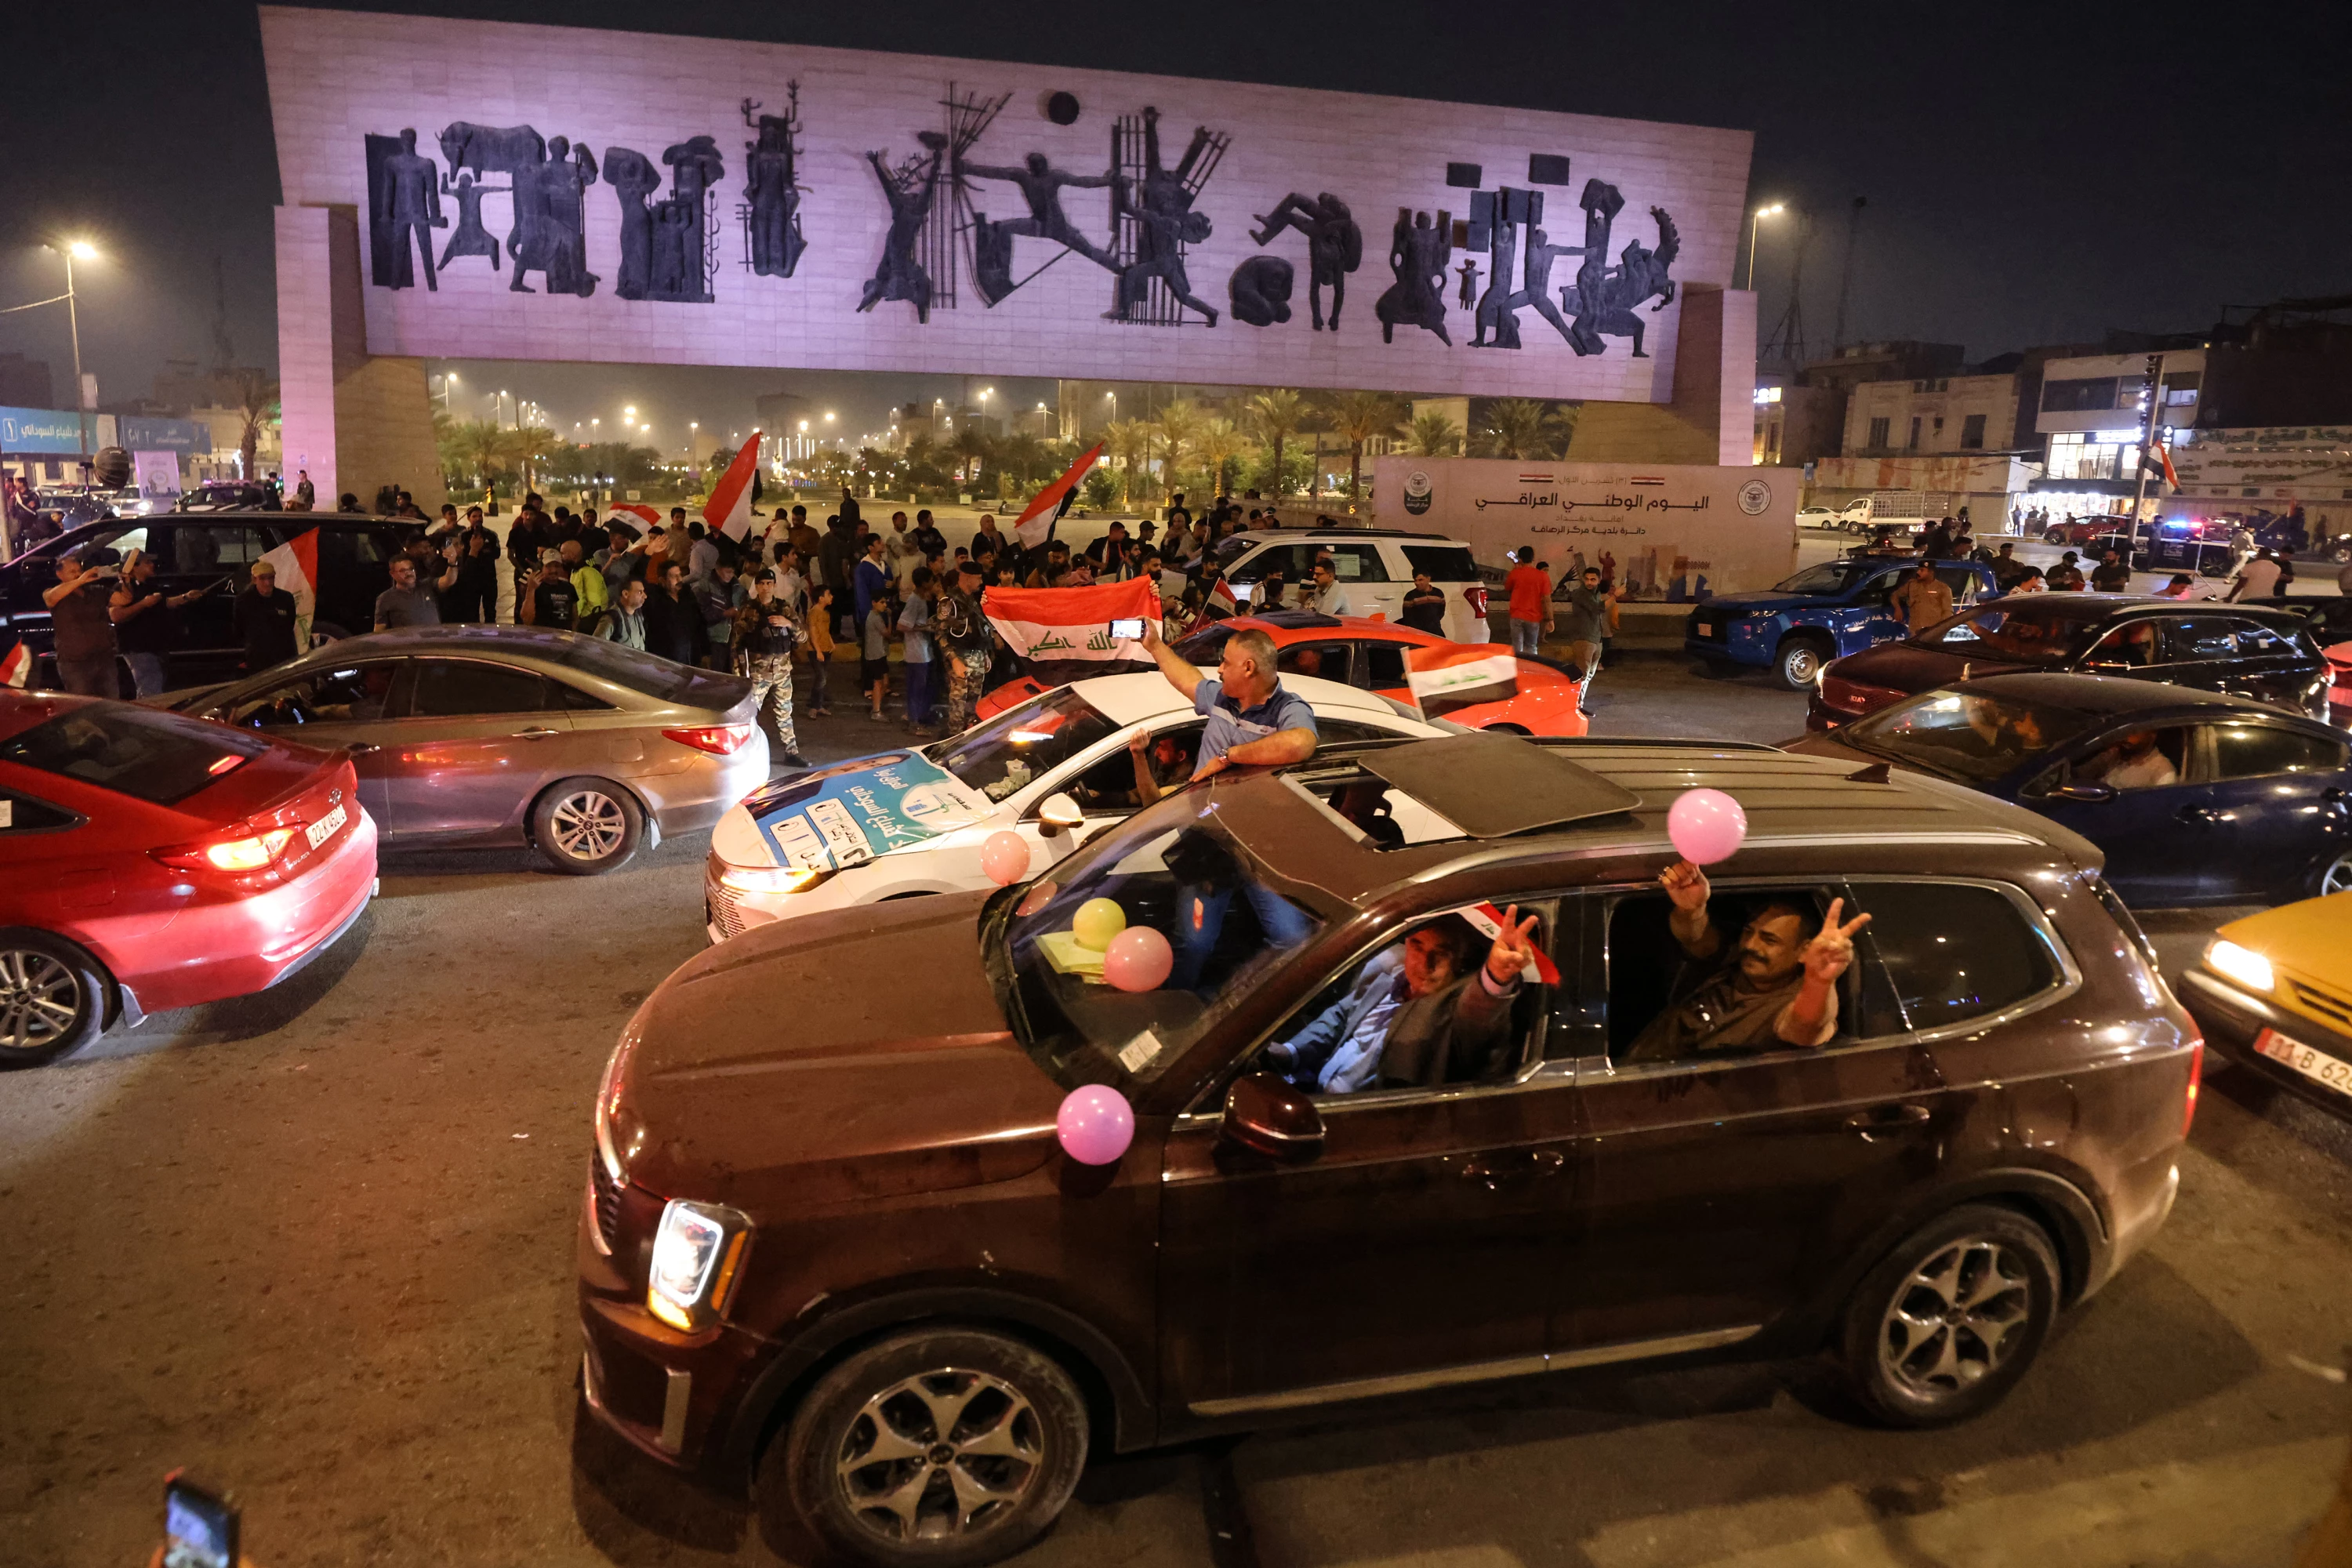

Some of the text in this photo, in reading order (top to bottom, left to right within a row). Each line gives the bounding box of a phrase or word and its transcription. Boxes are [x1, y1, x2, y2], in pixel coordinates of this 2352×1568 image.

[21, 424, 54, 438] السوداني
[1475, 492, 1709, 513] اليوم الوطني العراقي
[1531, 525, 1566, 535] الرصافة
[1567, 526, 1589, 535] مركز
[1592, 526, 1618, 535] بلدية
[1087, 629, 1118, 650] الله
[844, 786, 890, 817] السوداني
